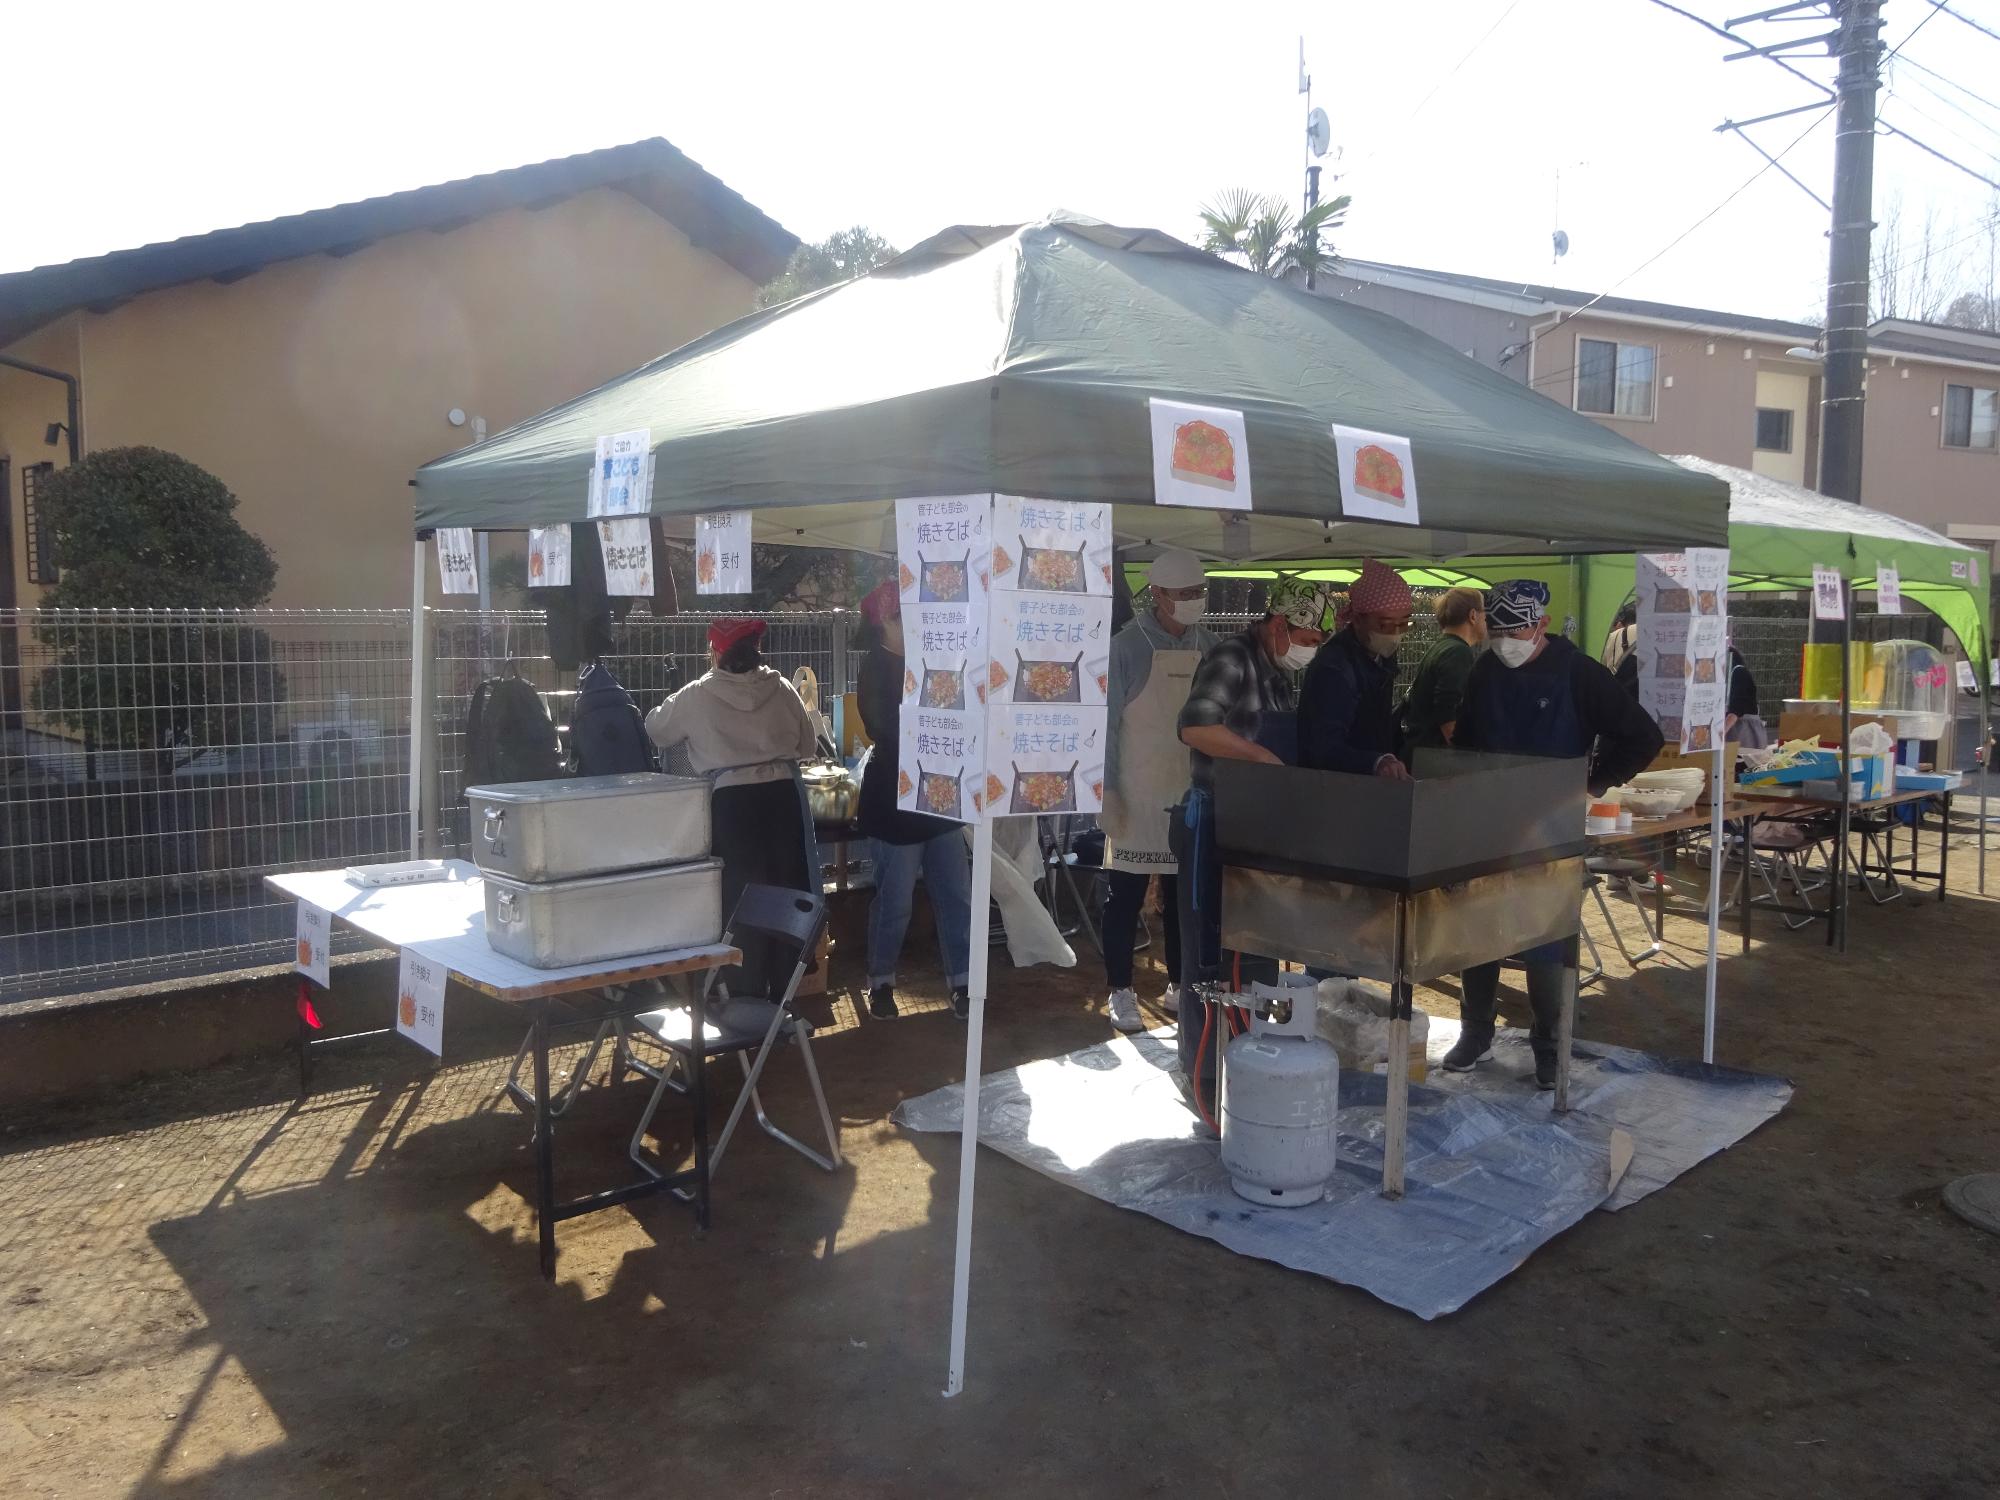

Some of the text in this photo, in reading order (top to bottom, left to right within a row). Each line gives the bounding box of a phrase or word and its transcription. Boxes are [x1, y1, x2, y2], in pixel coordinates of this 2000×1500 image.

[1020, 505, 1086, 532] 焼きそば
[917, 520, 970, 544] 焼きそば
[606, 545, 647, 571] 焼きそば
[720, 551, 740, 570] 受付
[922, 629, 968, 652] 焼きそば
[1016, 620, 1084, 643] 焼きそば
[917, 733, 965, 757] 焼きそば
[1013, 732, 1079, 753] 焼きそば
[421, 1005, 435, 1027] 受付
